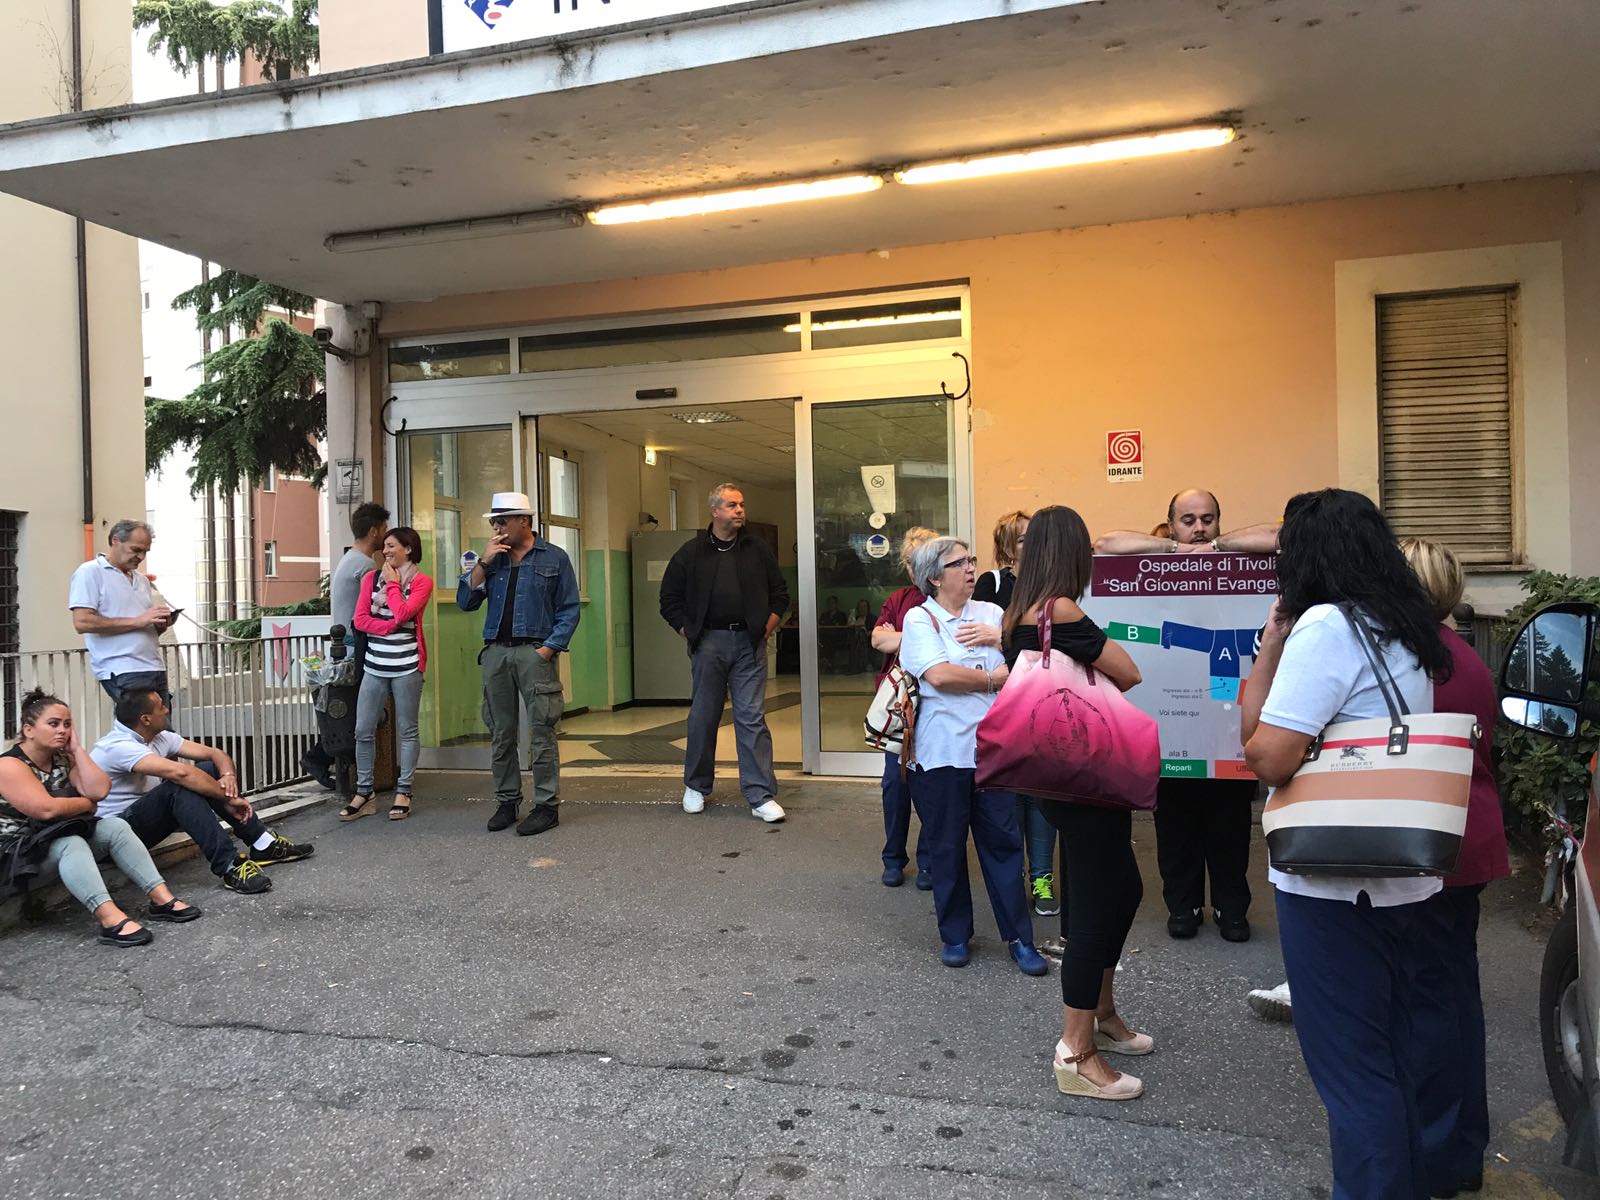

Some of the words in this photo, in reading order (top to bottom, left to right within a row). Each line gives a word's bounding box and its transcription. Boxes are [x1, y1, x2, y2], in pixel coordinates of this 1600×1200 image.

[1108, 467, 1142, 476] IDRANTE
[1138, 559, 1213, 576] Ospedale
[1217, 558, 1231, 572] di
[1235, 556, 1276, 571] Tivoli
[1144, 577, 1212, 593] Giovanni
[1127, 626, 1139, 640] B
[1218, 647, 1232, 661] A
[1189, 710, 1200, 718] qui
[1165, 763, 1192, 772] Reparti
